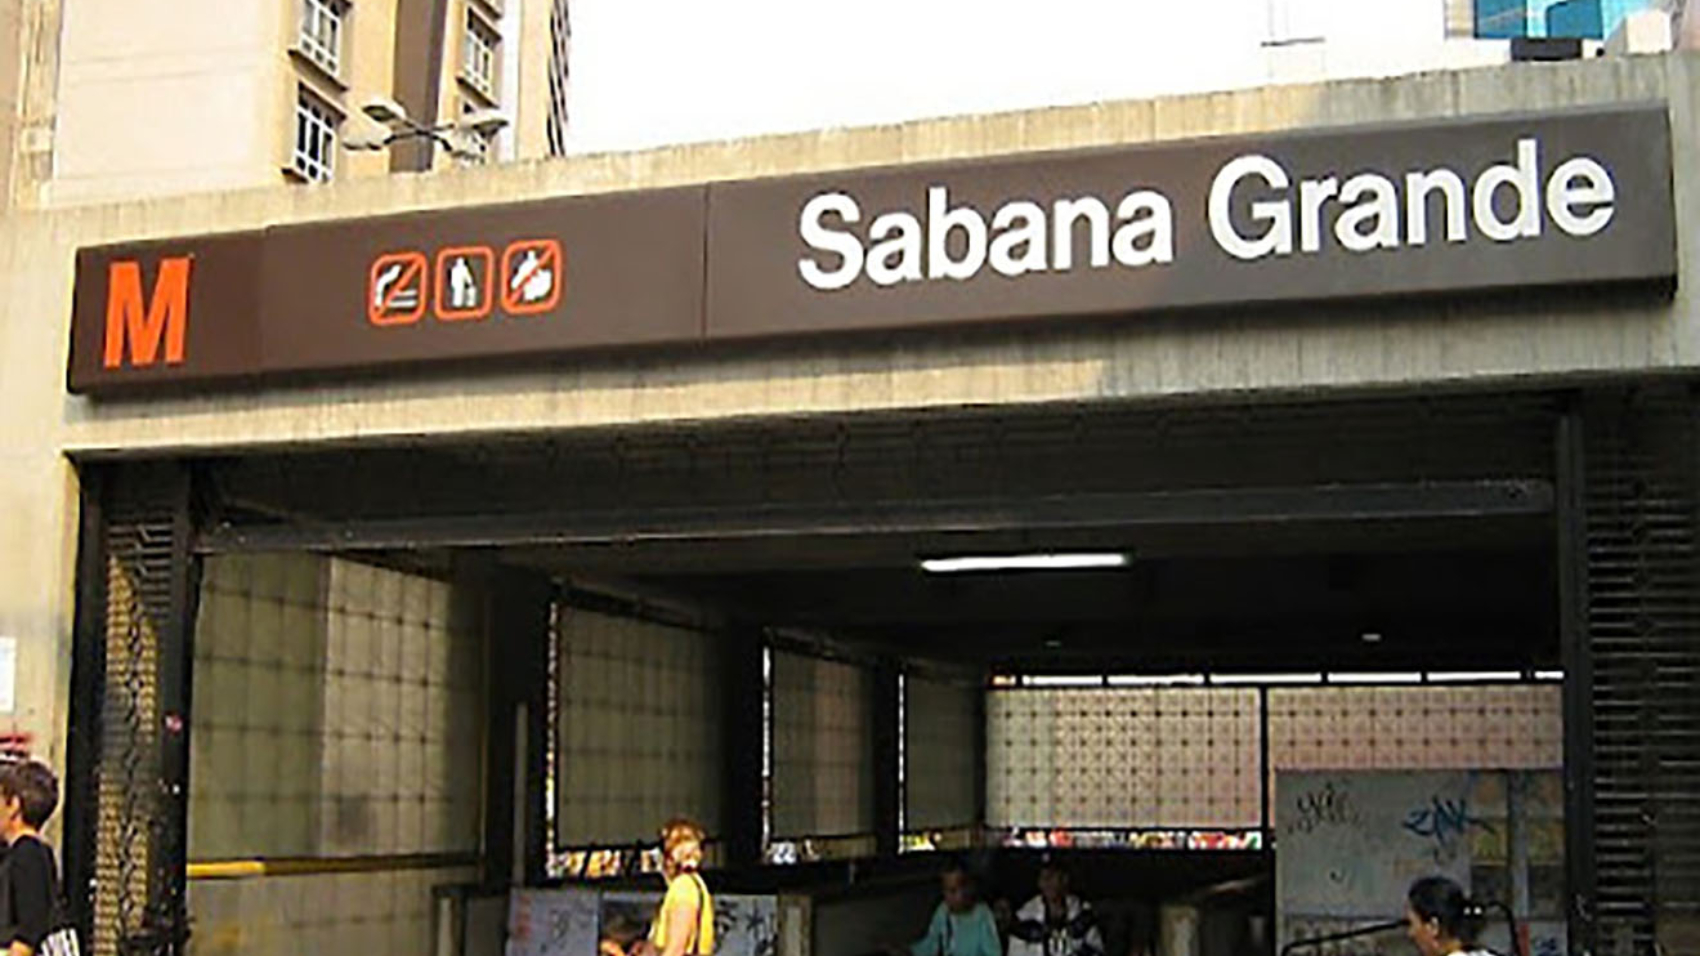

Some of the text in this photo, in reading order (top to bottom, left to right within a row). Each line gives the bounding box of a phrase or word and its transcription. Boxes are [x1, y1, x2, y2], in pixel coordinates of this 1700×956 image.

[798, 138, 1616, 290] Sabana Grande
[103, 258, 190, 368] M
